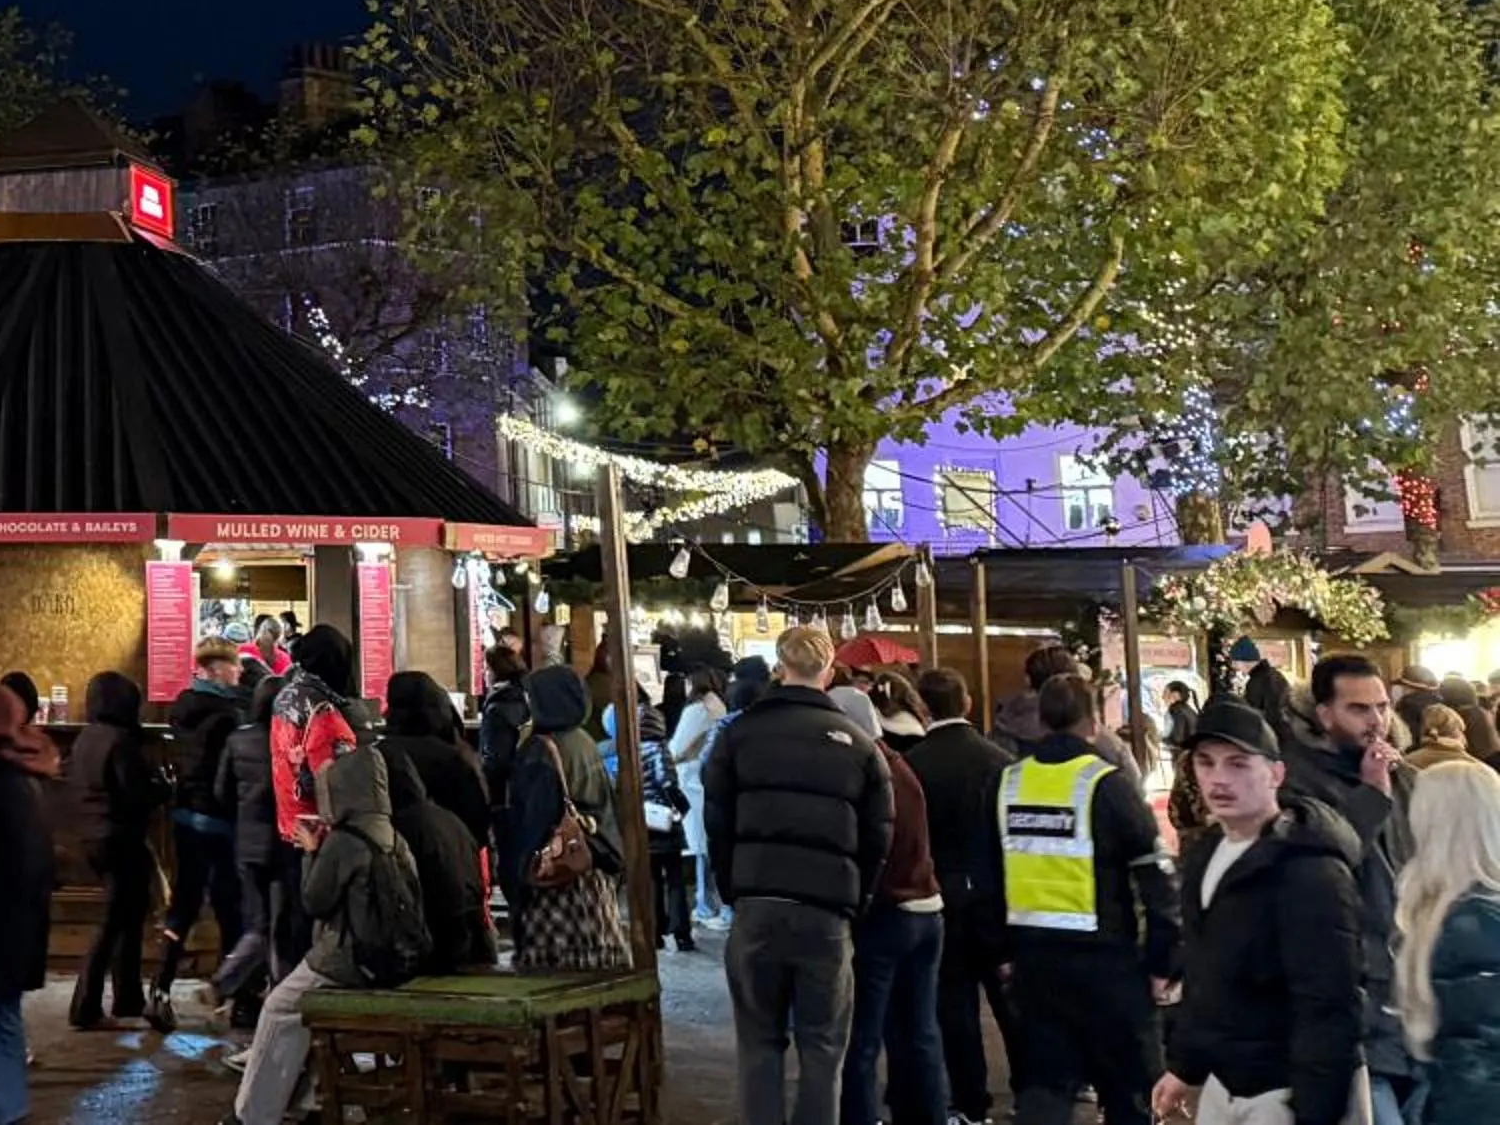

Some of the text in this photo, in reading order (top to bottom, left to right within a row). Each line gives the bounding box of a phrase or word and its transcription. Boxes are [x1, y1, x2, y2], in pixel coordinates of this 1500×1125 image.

[85, 522, 138, 533] BAILEYS
[217, 522, 401, 540] MULLED WINE & CIDER
